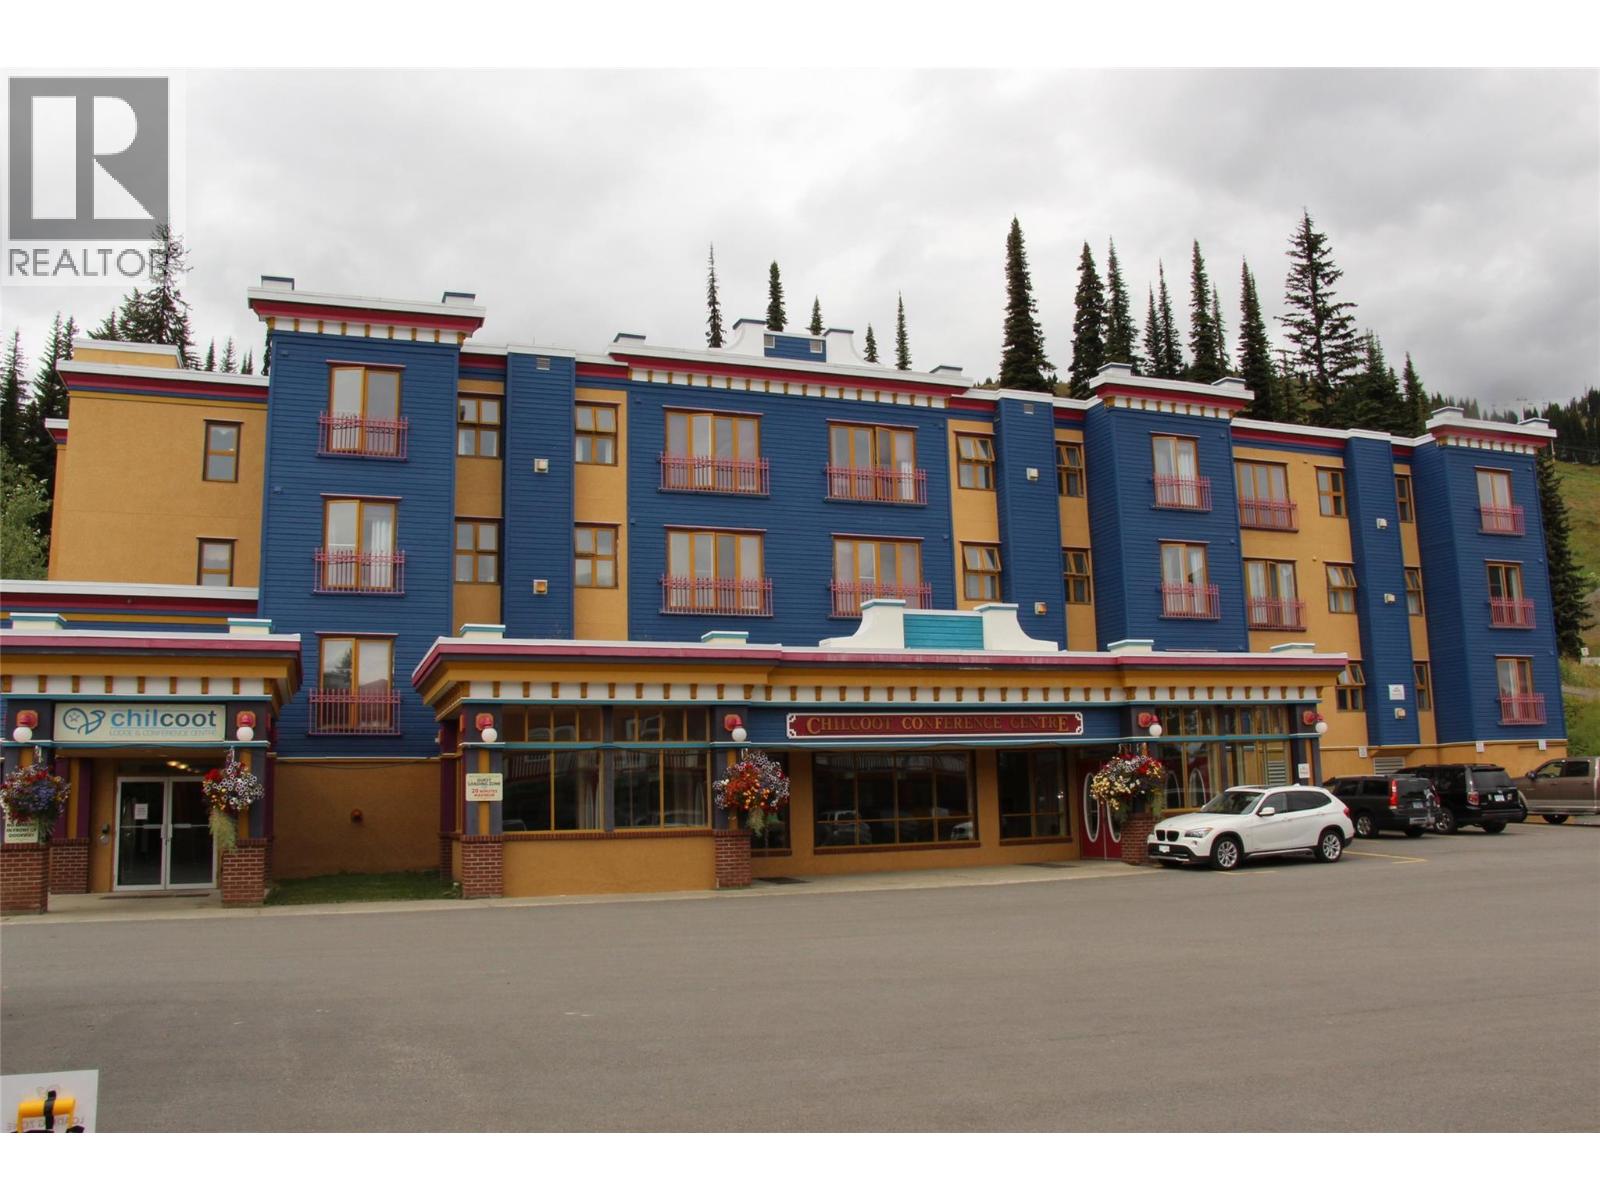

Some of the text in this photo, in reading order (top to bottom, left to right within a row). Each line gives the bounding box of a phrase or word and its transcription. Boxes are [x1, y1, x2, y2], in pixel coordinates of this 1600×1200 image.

[111, 709, 217, 727] chilcoot
[902, 716, 1001, 730] CONFERENCE
[1010, 716, 1069, 732] CENTRE
